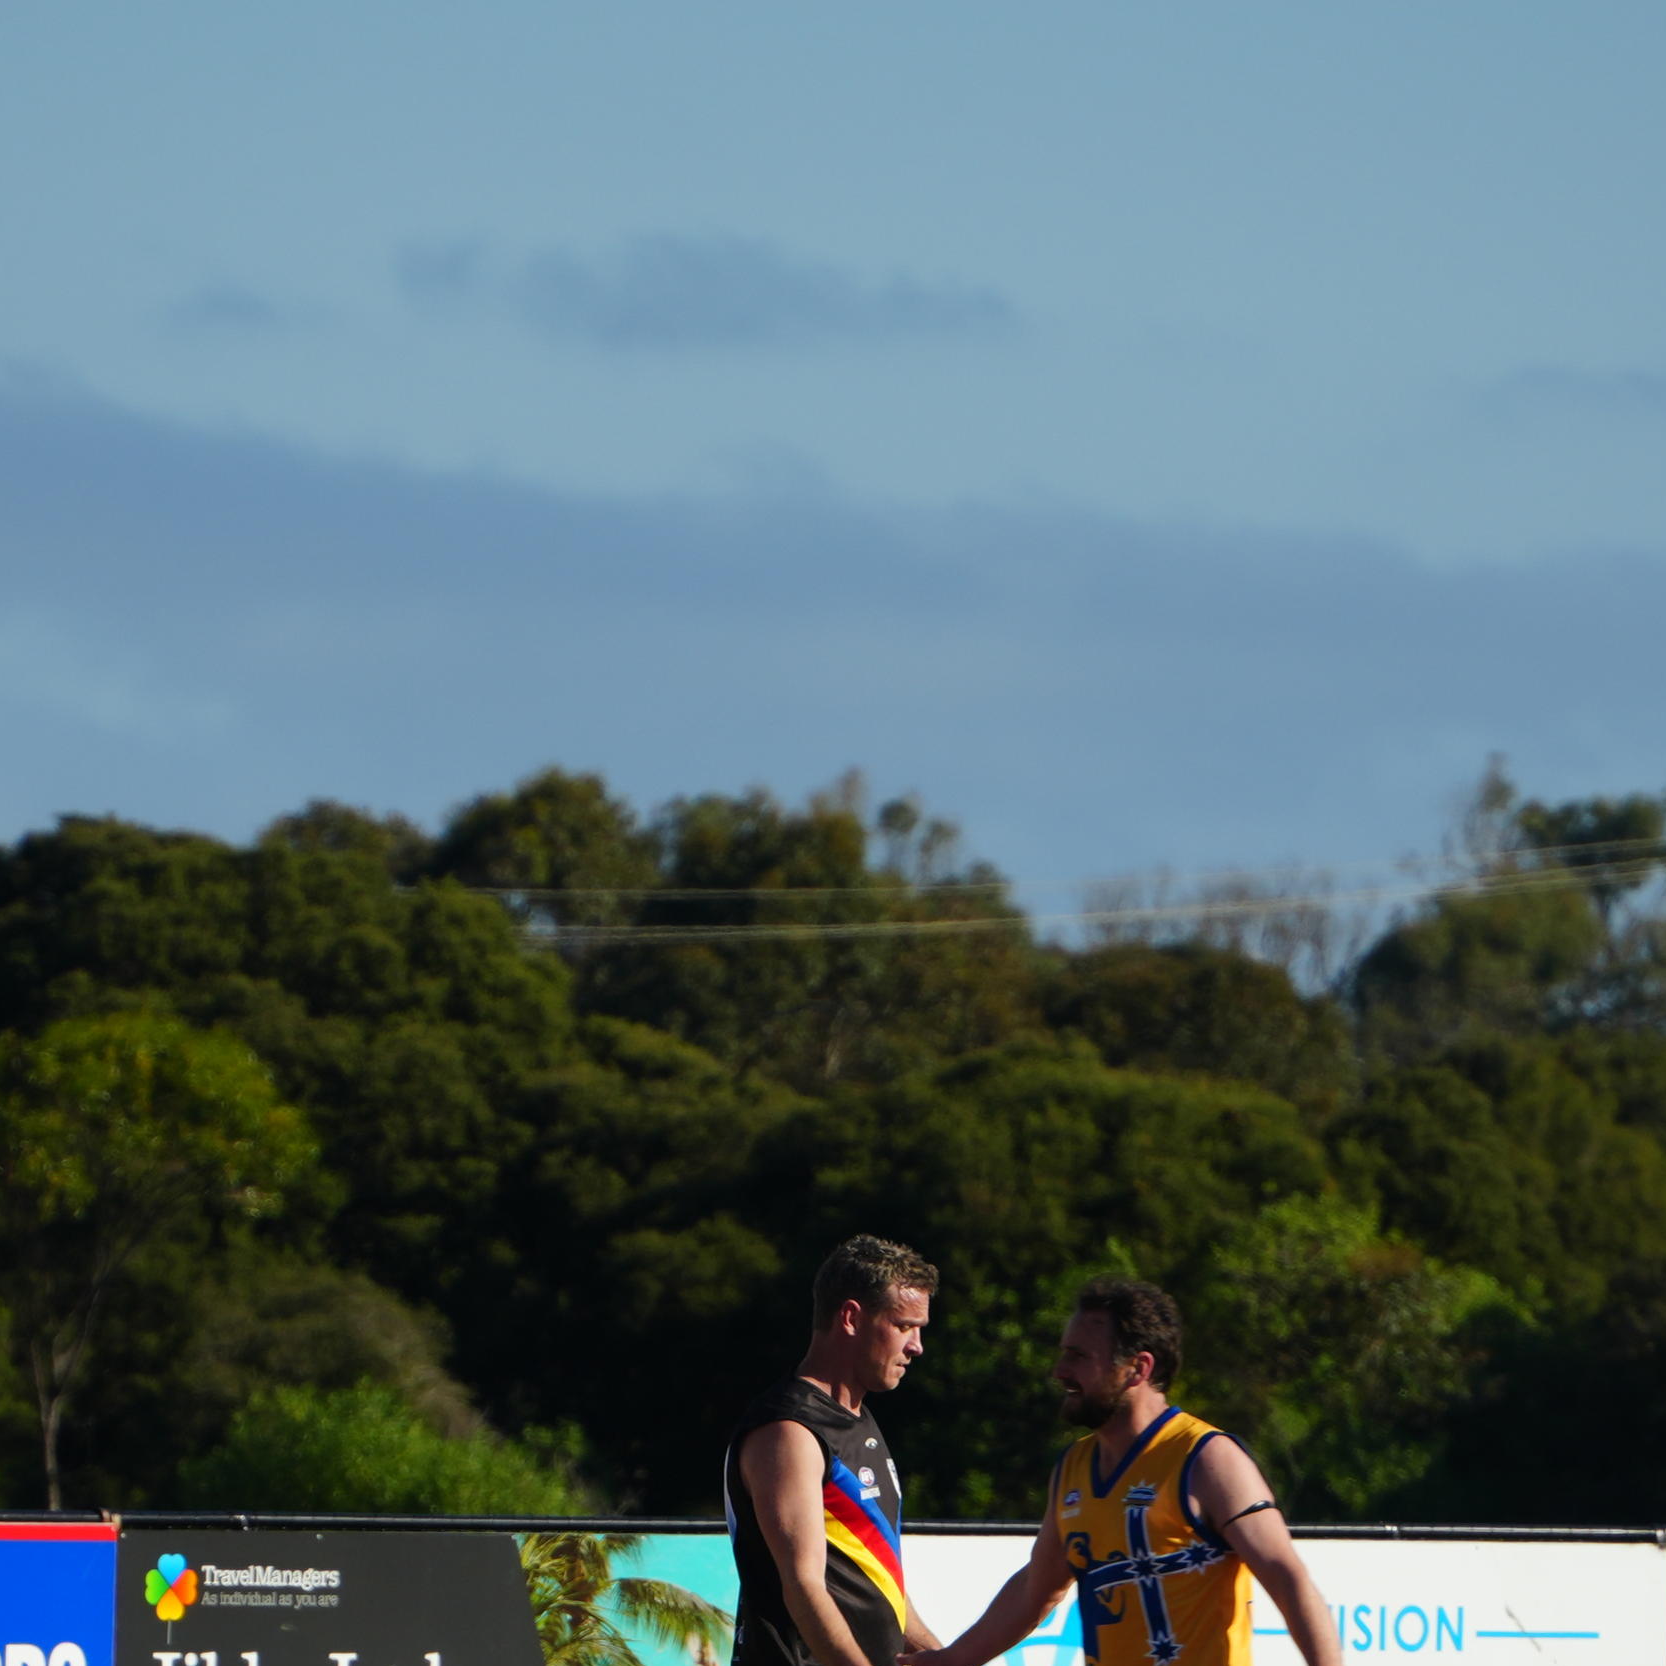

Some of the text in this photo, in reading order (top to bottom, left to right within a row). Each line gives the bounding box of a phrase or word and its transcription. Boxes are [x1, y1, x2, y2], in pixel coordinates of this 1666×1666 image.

[201, 1565, 340, 1591] TravelManagers
[201, 1592, 338, 1610] As individual as you are
[1327, 1604, 1464, 1652] ISION
